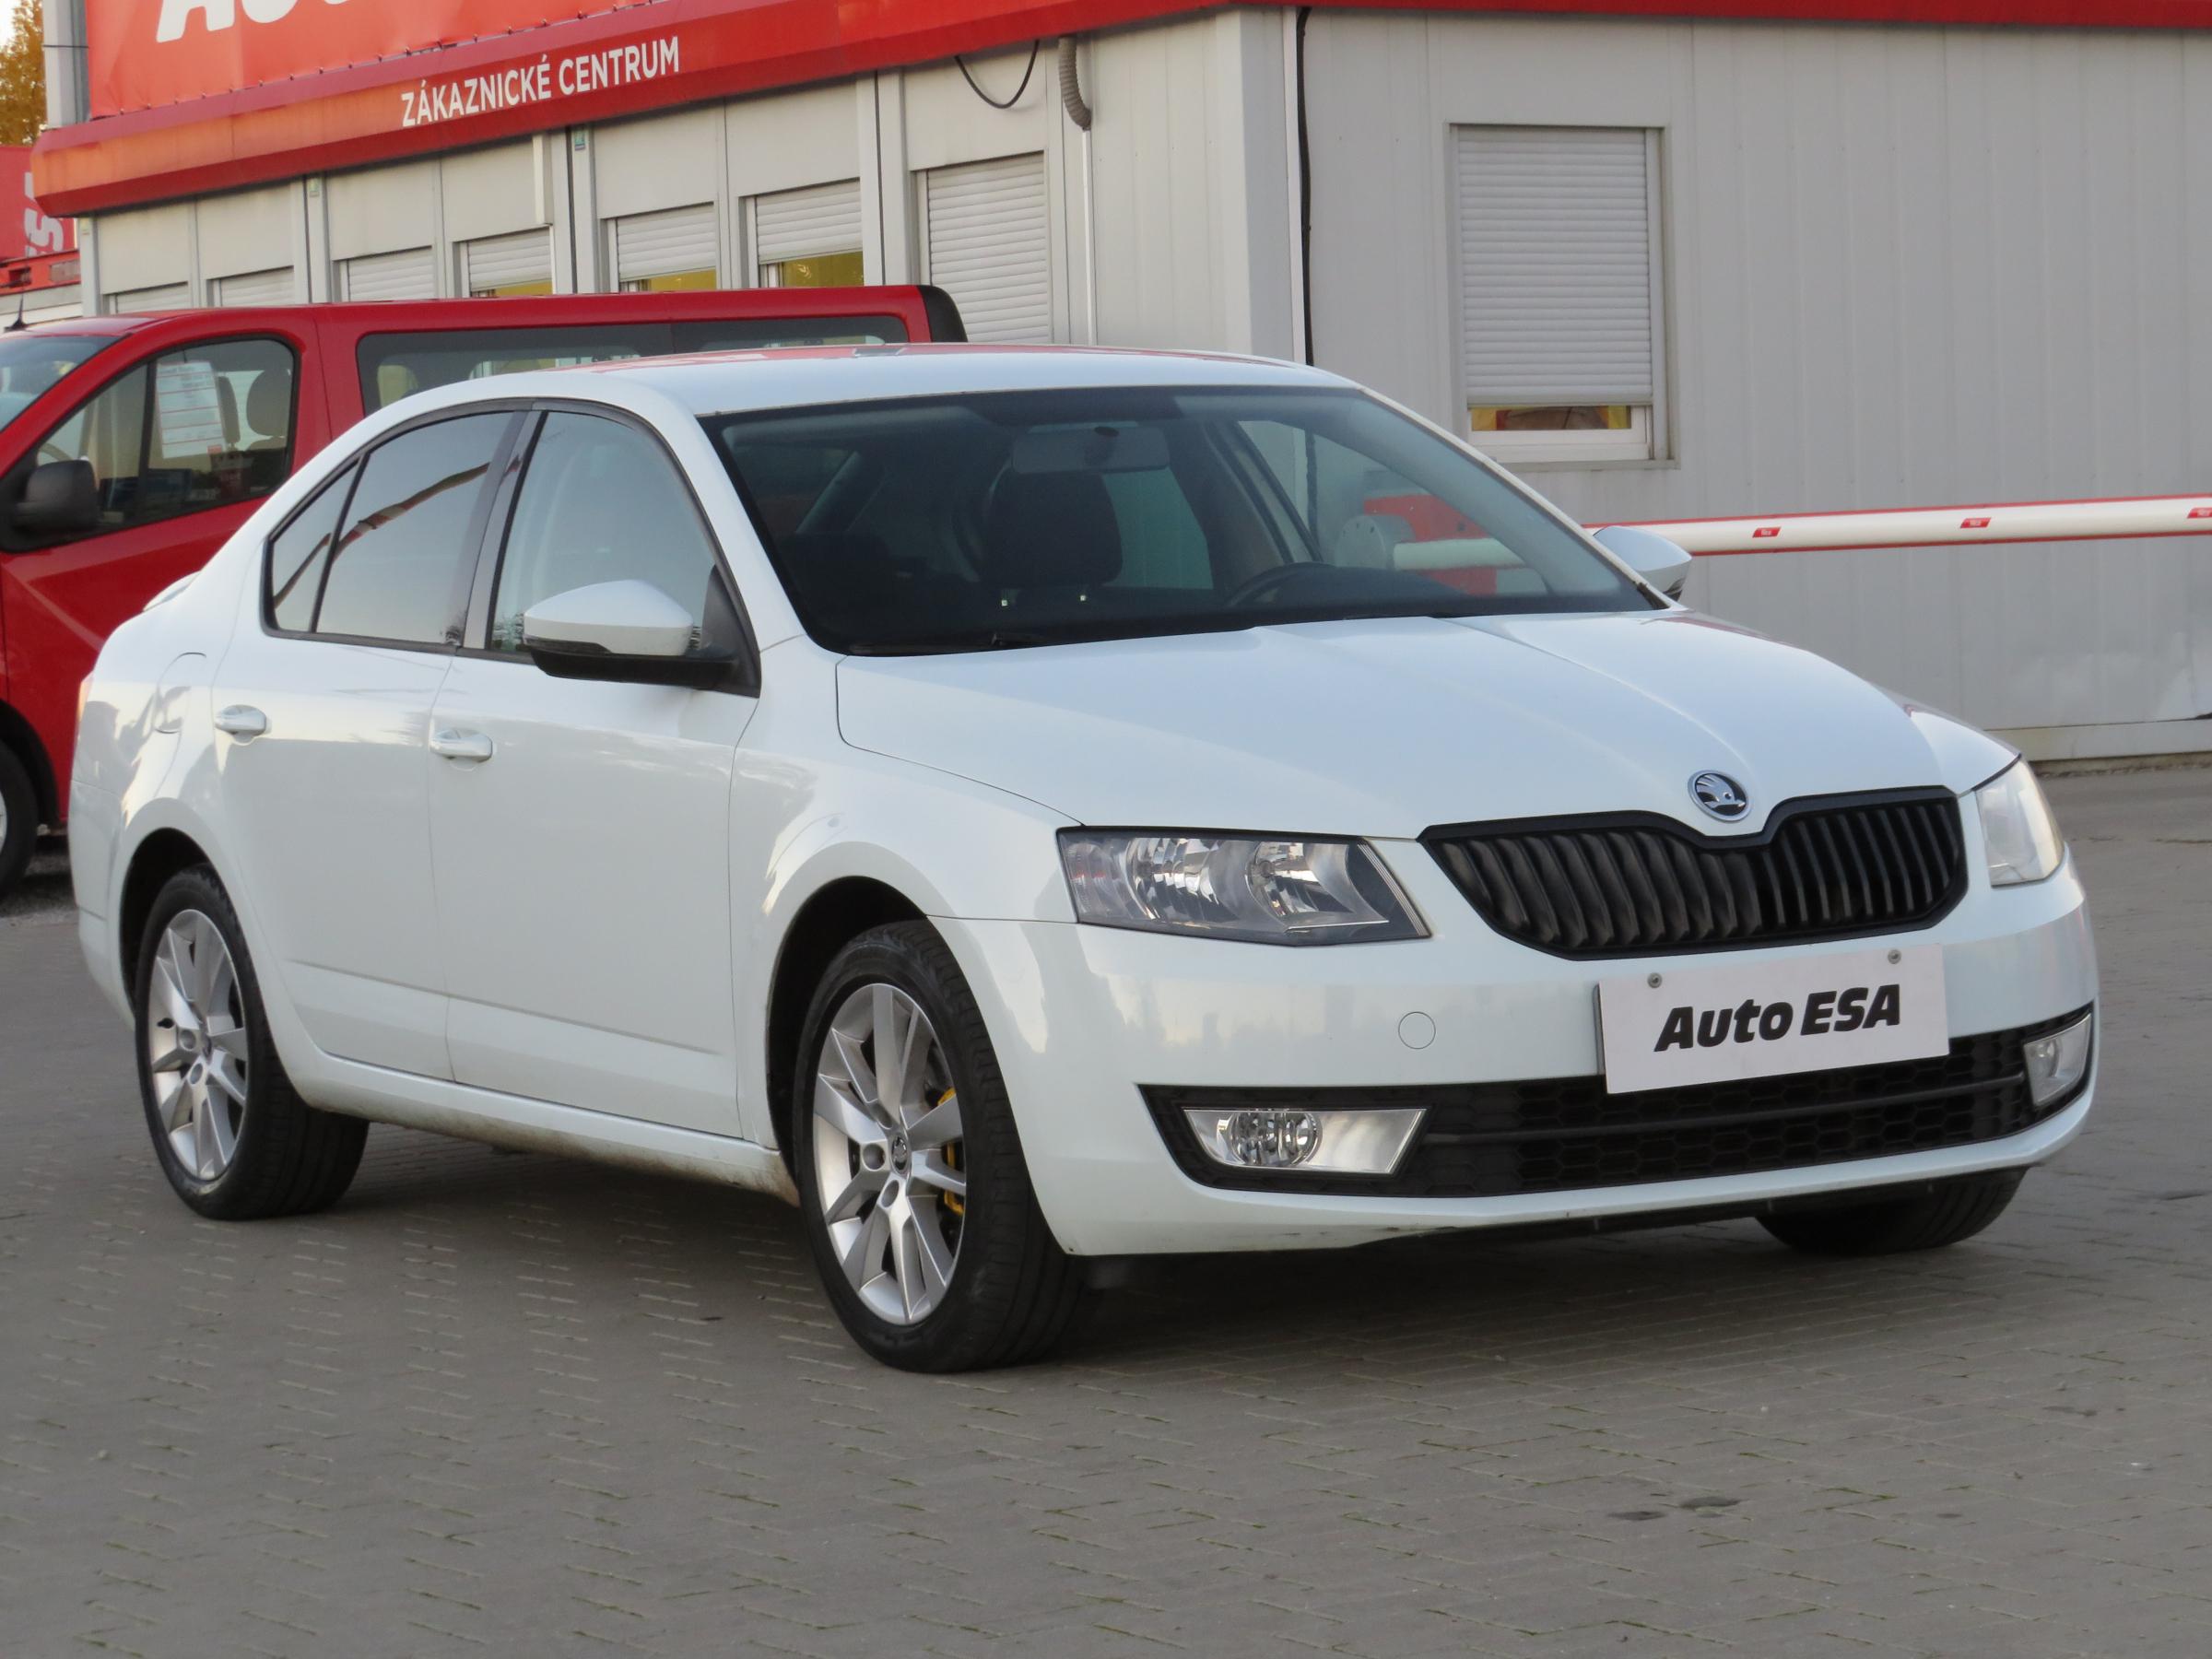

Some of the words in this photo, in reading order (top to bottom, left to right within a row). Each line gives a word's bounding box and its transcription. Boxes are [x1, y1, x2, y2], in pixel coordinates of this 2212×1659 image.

[401, 53, 552, 127] ZÁKAZNICKÉ
[559, 35, 679, 96] CENTRUM
[1653, 998, 1794, 1052] Auto
[1800, 983, 1900, 1036] ESA
